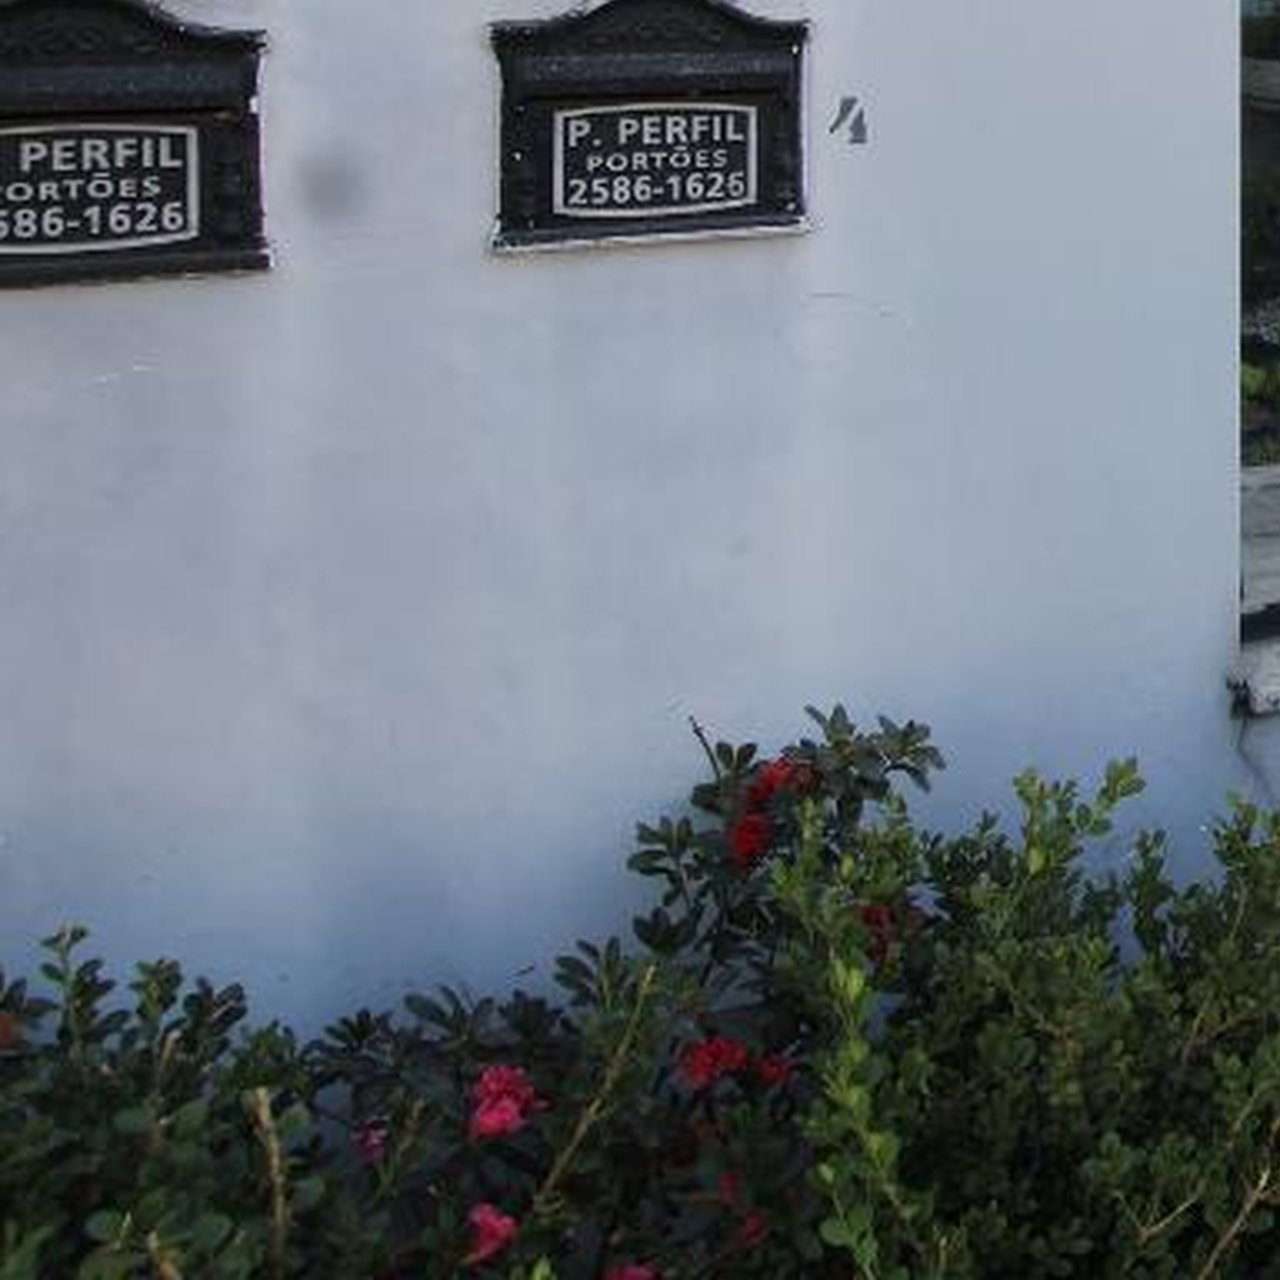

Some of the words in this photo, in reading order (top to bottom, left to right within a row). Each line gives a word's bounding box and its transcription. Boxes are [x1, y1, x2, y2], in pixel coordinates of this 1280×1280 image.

[568, 119, 601, 147] P.
[618, 115, 745, 145] PERFIL
[20, 137, 183, 172] PERFIL
[587, 145, 728, 172] PORTÕES
[0, 172, 161, 202] ORTÕES
[568, 172, 745, 205] 2586-1626
[0, 202, 184, 239] 86-1626
